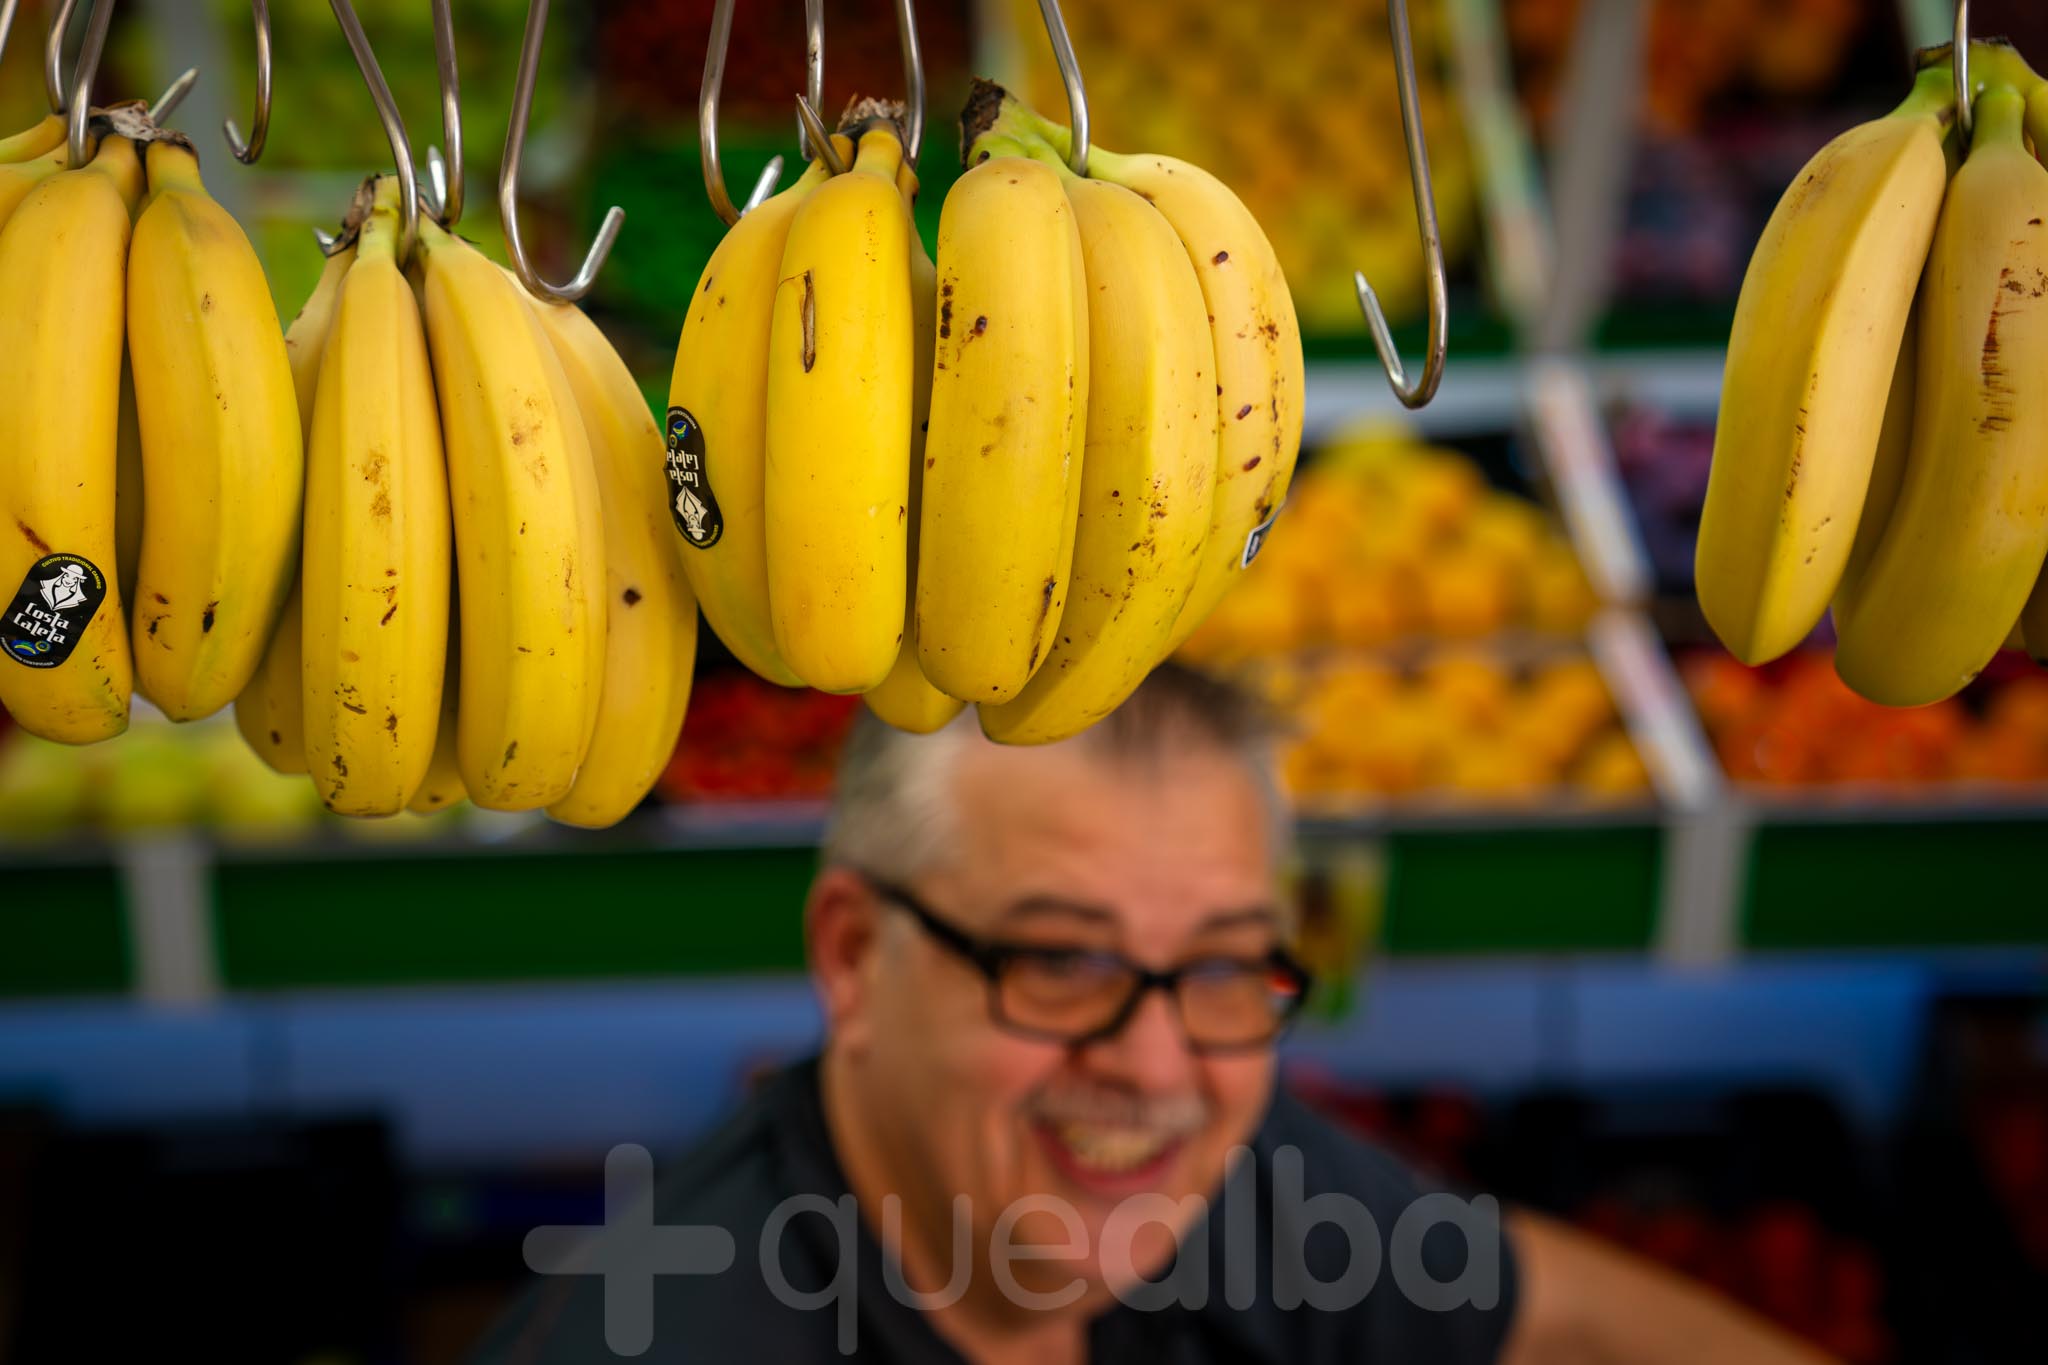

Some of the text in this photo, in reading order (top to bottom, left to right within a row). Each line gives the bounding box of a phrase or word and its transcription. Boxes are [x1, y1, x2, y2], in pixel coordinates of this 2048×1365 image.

[666, 448, 699, 470] Caleta
[669, 467, 699, 488] Costa
[13, 612, 66, 644] Caleta
[24, 602, 70, 630] Costa
